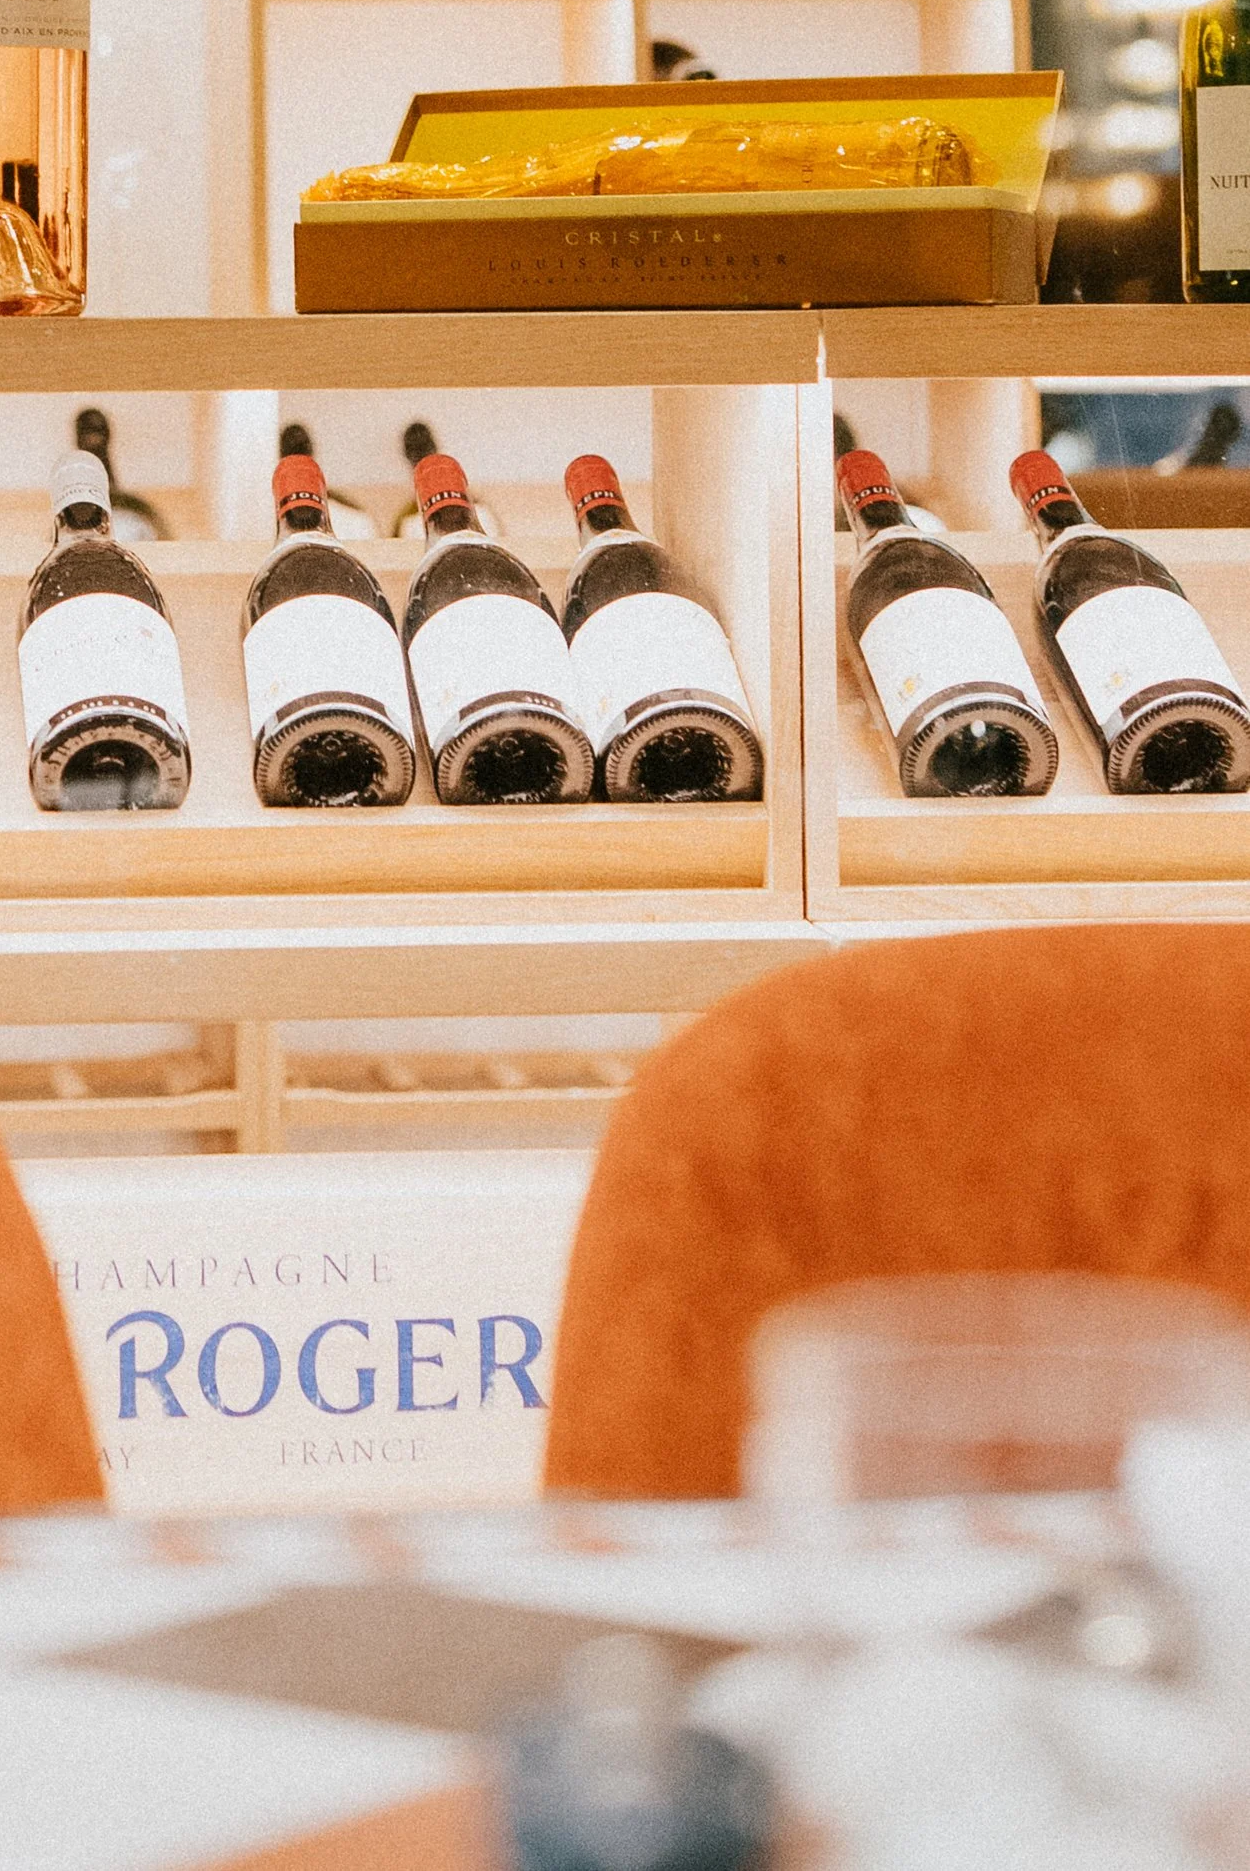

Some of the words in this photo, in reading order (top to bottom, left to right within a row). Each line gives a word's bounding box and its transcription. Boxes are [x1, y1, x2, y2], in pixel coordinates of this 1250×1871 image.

[488, 256, 588, 272] LOUIS
[52, 1251, 393, 1292] HAMPAGNE
[105, 1309, 550, 1420] ROGER
[279, 1438, 426, 1467] FRANCE
